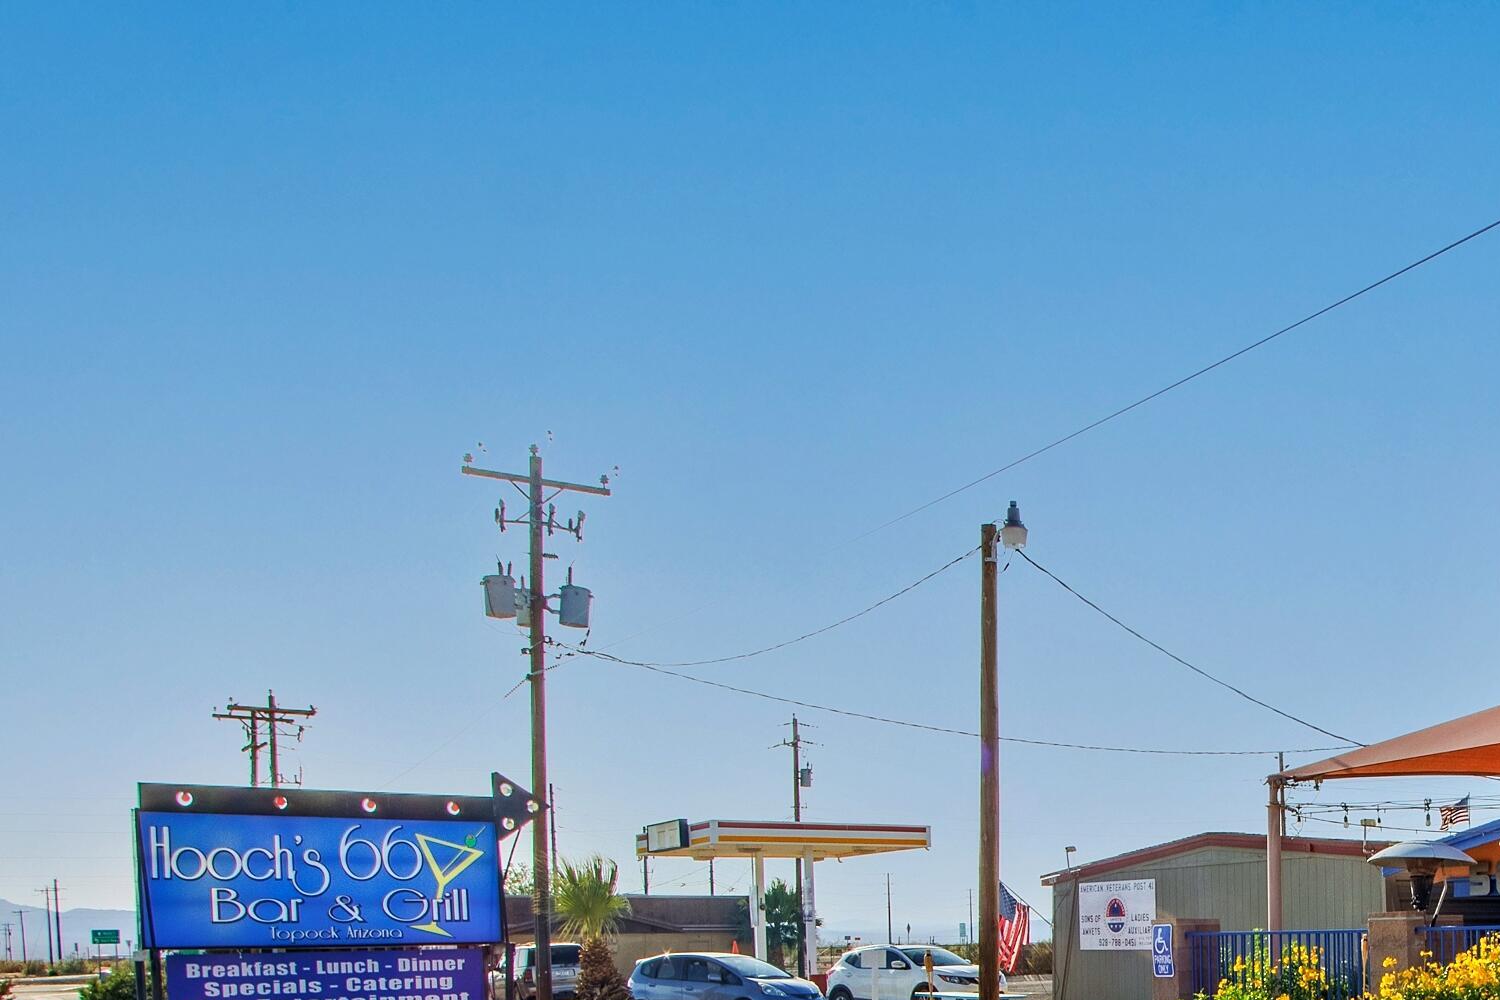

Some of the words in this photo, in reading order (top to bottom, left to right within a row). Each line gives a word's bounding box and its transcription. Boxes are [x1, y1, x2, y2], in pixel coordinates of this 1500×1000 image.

[150, 825, 331, 896] Hooch's
[339, 824, 424, 880] 66
[1106, 884, 1131, 892] VETERANS
[1133, 882, 1147, 890] POST
[210, 887, 303, 923] Bar
[328, 895, 365, 922] &
[382, 888, 468, 922] Grill
[1130, 913, 1150, 922] LADIES
[270, 926, 339, 943] Topock
[346, 926, 403, 939] Arizona
[1128, 926, 1152, 935] AUXILIAR
[1154, 954, 1172, 964] PARKING
[186, 961, 298, 979] Breakfast
[316, 959, 379, 974] Lunch
[397, 957, 466, 972] Dinner
[1157, 965, 1169, 974] ONLY
[204, 979, 322, 997] Specials
[346, 976, 453, 992] Catering
